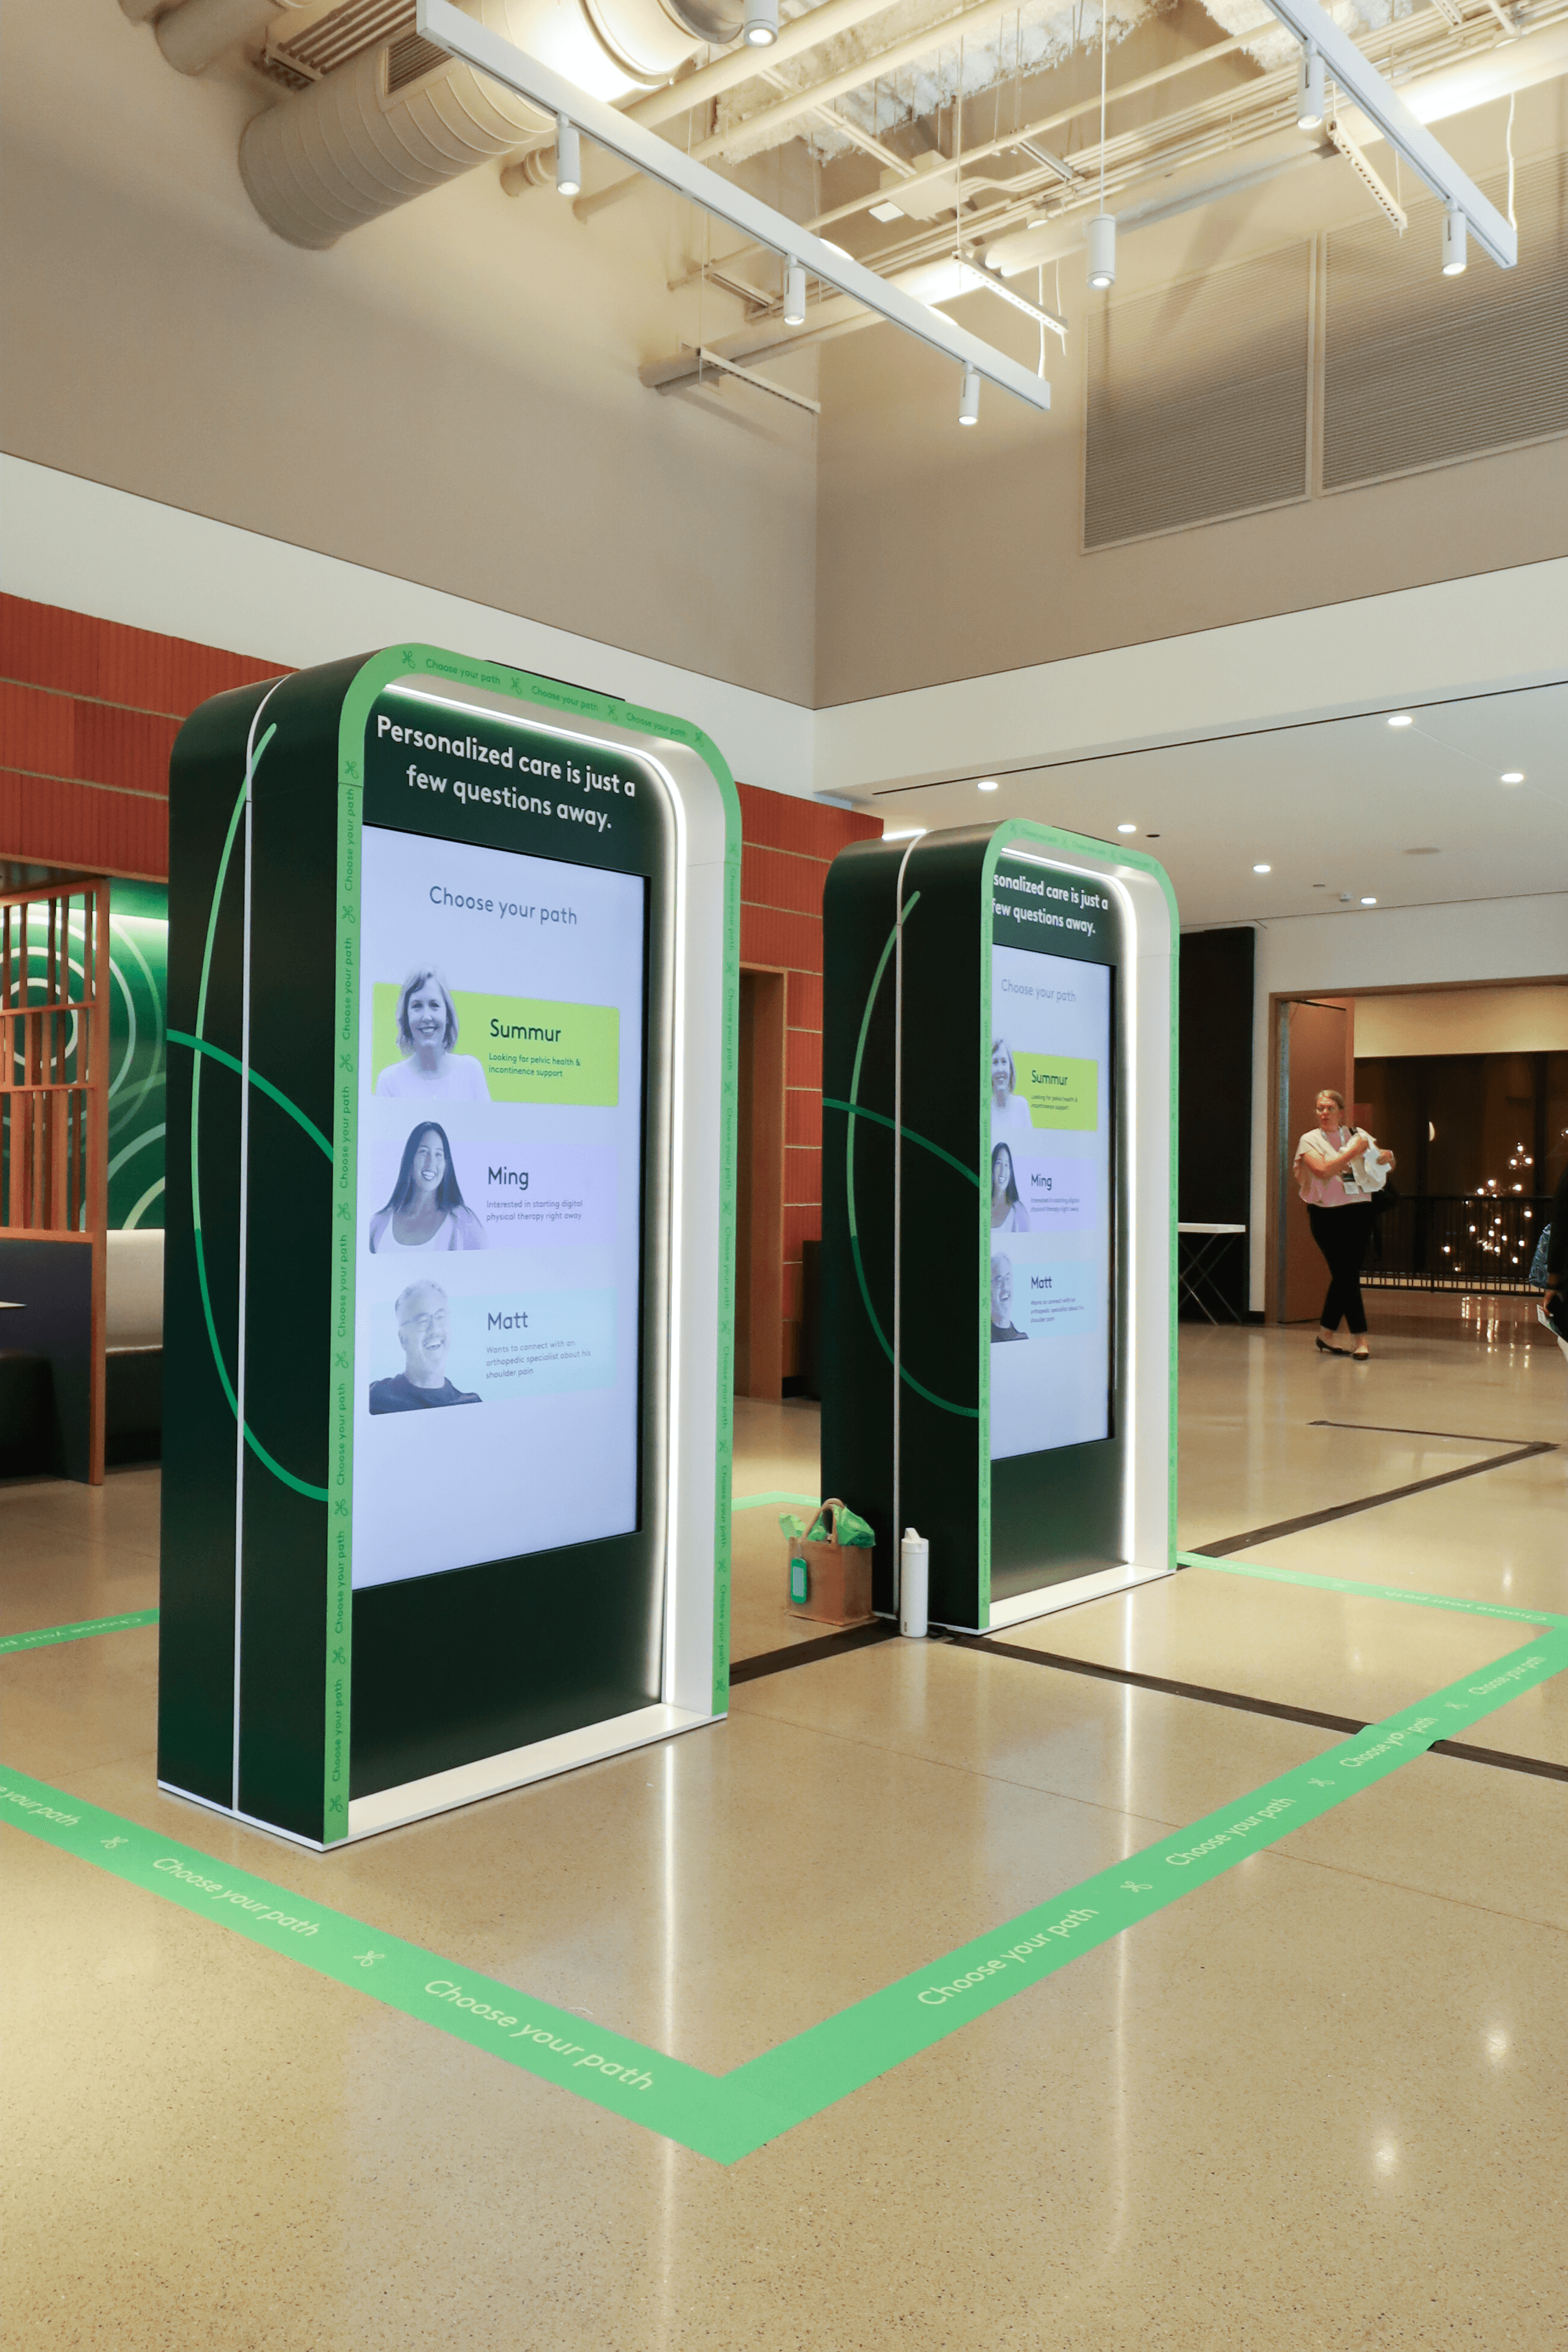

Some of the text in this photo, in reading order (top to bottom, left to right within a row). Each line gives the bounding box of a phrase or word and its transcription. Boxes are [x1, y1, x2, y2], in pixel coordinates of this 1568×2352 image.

[426, 659, 500, 685] Choose your path
[377, 714, 635, 797] Personalized care is just a
[345, 789, 354, 815] path
[406, 764, 612, 832] few questions away.
[344, 849, 353, 891] Choose
[430, 886, 577, 925] Choose your path
[993, 874, 1108, 910] sonalized care is just a
[992, 898, 1096, 936] few questions away.
[342, 938, 353, 1040] Choose your path
[1001, 979, 1076, 1003] Choose your path
[490, 1018, 561, 1042] Summur
[489, 1052, 517, 1064] Looking
[518, 1054, 529, 1063] for
[531, 1056, 550, 1065] pelvic
[552, 1057, 574, 1066] health
[489, 1065, 563, 1078] incontinence support
[1031, 1070, 1068, 1086] Summur
[340, 1086, 351, 1189] Choose your path
[488, 1166, 529, 1191] Ming
[1031, 1174, 1053, 1191] Ming
[486, 1213, 515, 1222] physical
[517, 1213, 544, 1221] therapy
[546, 1212, 563, 1221] right
[532, 1201, 560, 1209] starting
[561, 1200, 583, 1209] digital
[337, 1235, 348, 1338] Choose your path
[1031, 1276, 1053, 1289] Matt
[488, 1312, 529, 1330] Matt
[486, 1345, 509, 1354] Wants
[520, 1342, 548, 1351] connect
[549, 1340, 564, 1348] with
[486, 1357, 524, 1366] orthopedic
[526, 1353, 558, 1364] specialist
[560, 1350, 580, 1359] about
[486, 1368, 534, 1379] shoulder pain
[337, 1383, 346, 1411] path
[337, 1443, 345, 1486] Choose
[335, 1532, 345, 1634] Choose your path
[332, 1679, 343, 1782] Choose your path
[1339, 1742, 1391, 1767] Choose
[1, 1790, 79, 1827] your path
[1165, 1798, 1296, 1865] Choose your path
[152, 1857, 319, 1937] Choose your path
[917, 1909, 1100, 2005] Choose your path
[425, 1981, 654, 2090] Choose your path
